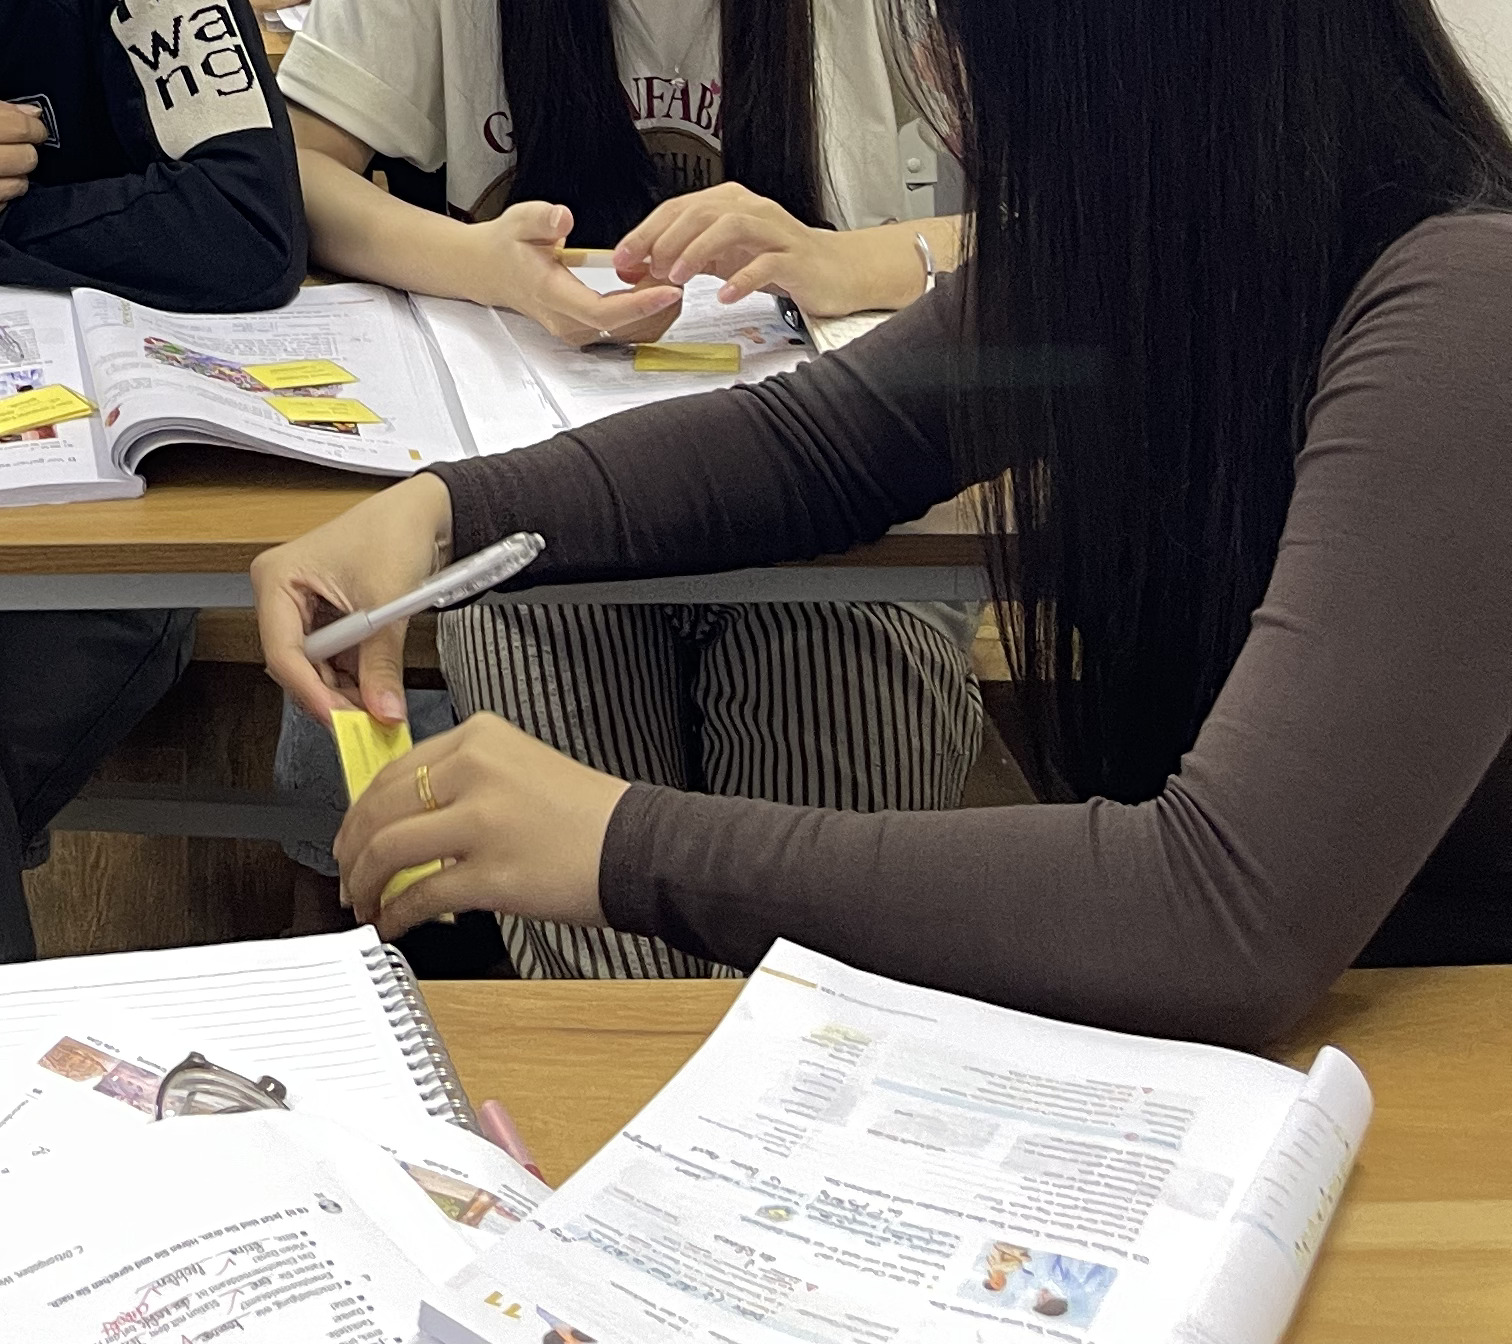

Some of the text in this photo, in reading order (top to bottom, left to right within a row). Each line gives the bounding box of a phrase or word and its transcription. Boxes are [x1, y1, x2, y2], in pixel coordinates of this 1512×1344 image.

[127, 4, 238, 72] wa
[155, 44, 254, 111] ng
[198, 1229, 223, 1241] dran.
[224, 1225, 240, 1233] Sie
[170, 1238, 199, 1253] Hören
[154, 1249, 170, 1259] Sie
[14, 1249, 74, 1277] Ortsangaben,
[134, 1256, 153, 1269] und
[91, 1265, 134, 1290] sprechen
[75, 1286, 91, 1297] Sie
[194, 1288, 209, 1299] ist
[47, 1293, 74, 1308] nach.
[149, 1299, 220, 1337] Station mit dem
